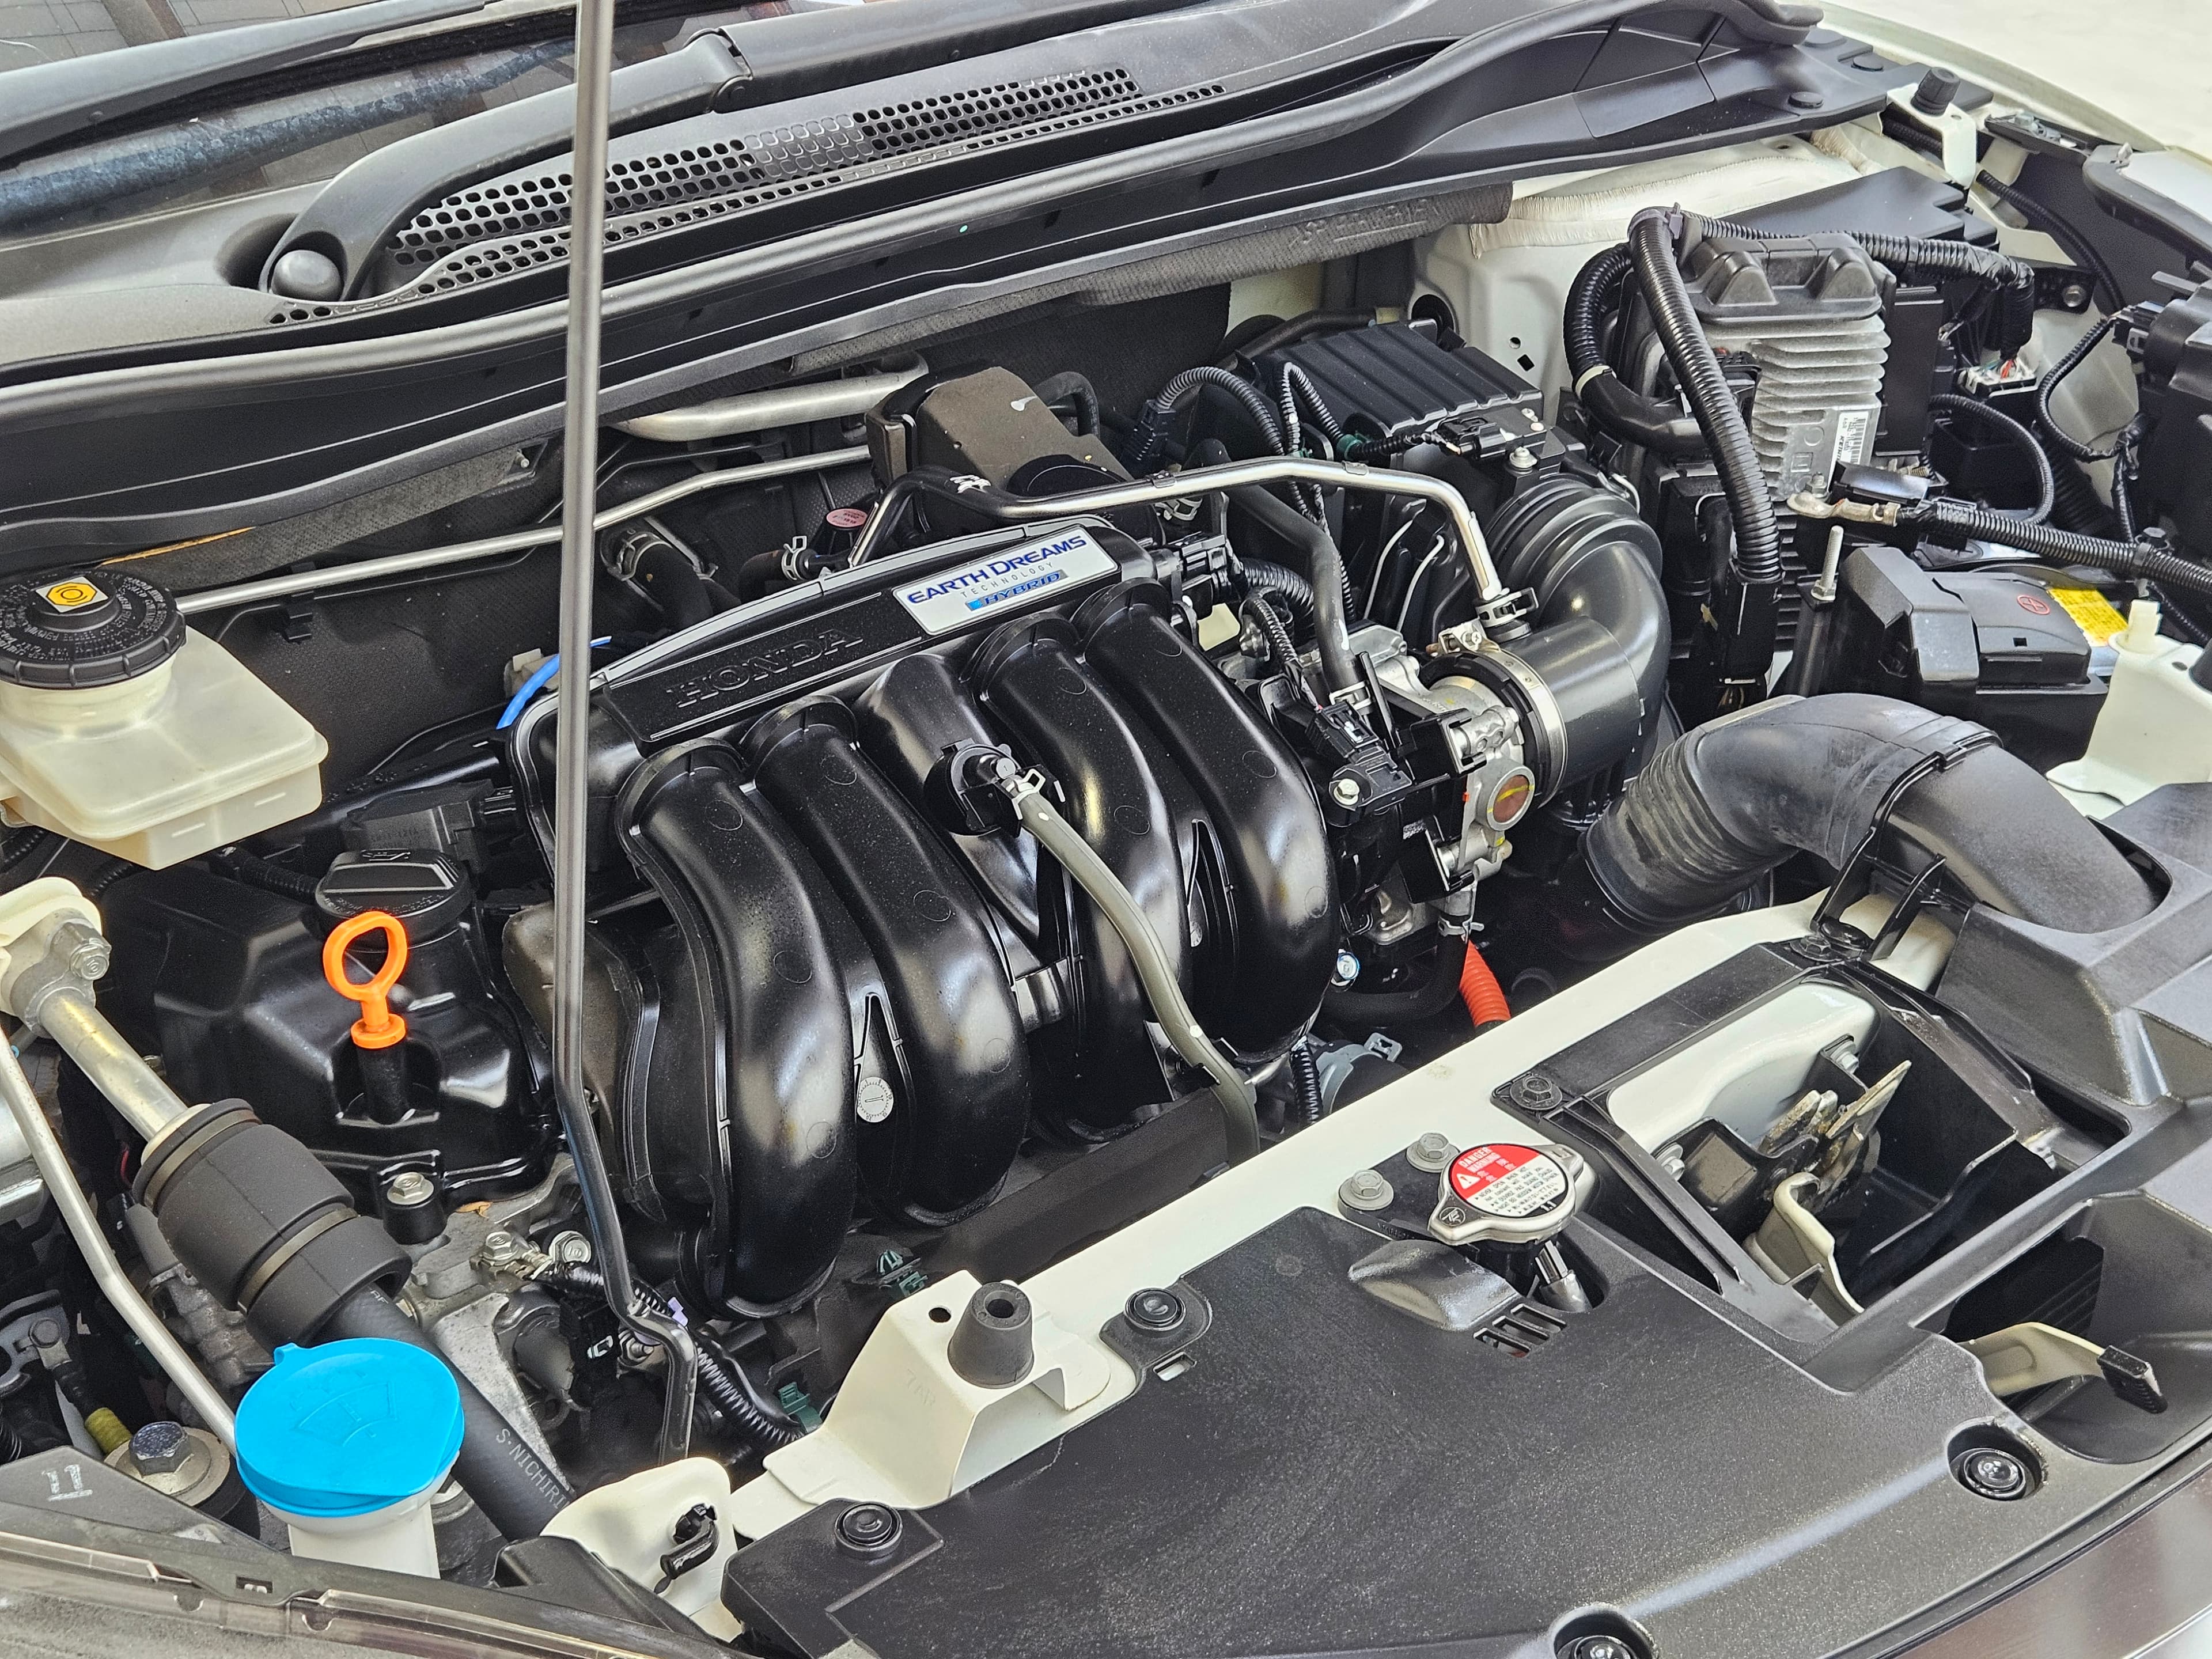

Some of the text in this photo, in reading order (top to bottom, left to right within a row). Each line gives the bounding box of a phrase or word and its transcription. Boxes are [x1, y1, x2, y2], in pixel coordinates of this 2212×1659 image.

[908, 536, 1088, 604] EARTH DREAMS
[963, 562, 1054, 598] TECHNOLOGY
[984, 571, 1062, 605] HYBRID
[666, 629, 863, 707] HONDA
[1459, 1146, 1493, 1168] DANGER
[1540, 1201, 1557, 1212] 1.1
